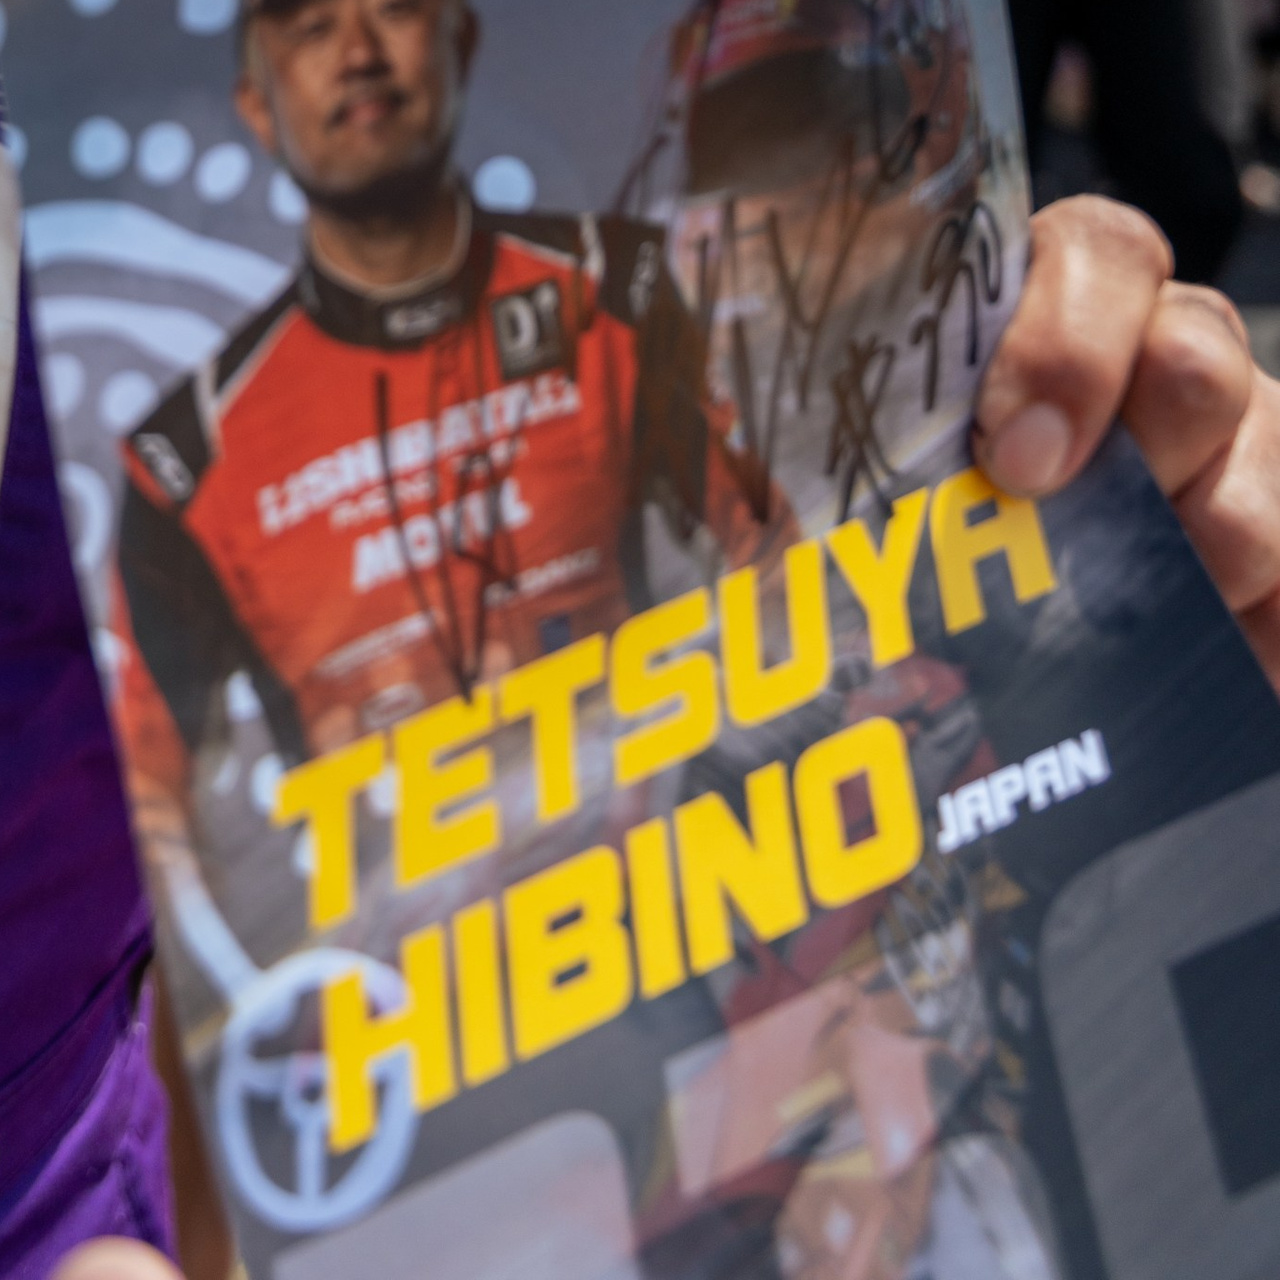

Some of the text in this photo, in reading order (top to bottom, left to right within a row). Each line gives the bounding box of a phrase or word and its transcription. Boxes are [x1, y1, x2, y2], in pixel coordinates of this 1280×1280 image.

[271, 466, 1057, 930] TETSUYA
[321, 714, 1112, 1157] HIBINO JAPAN
